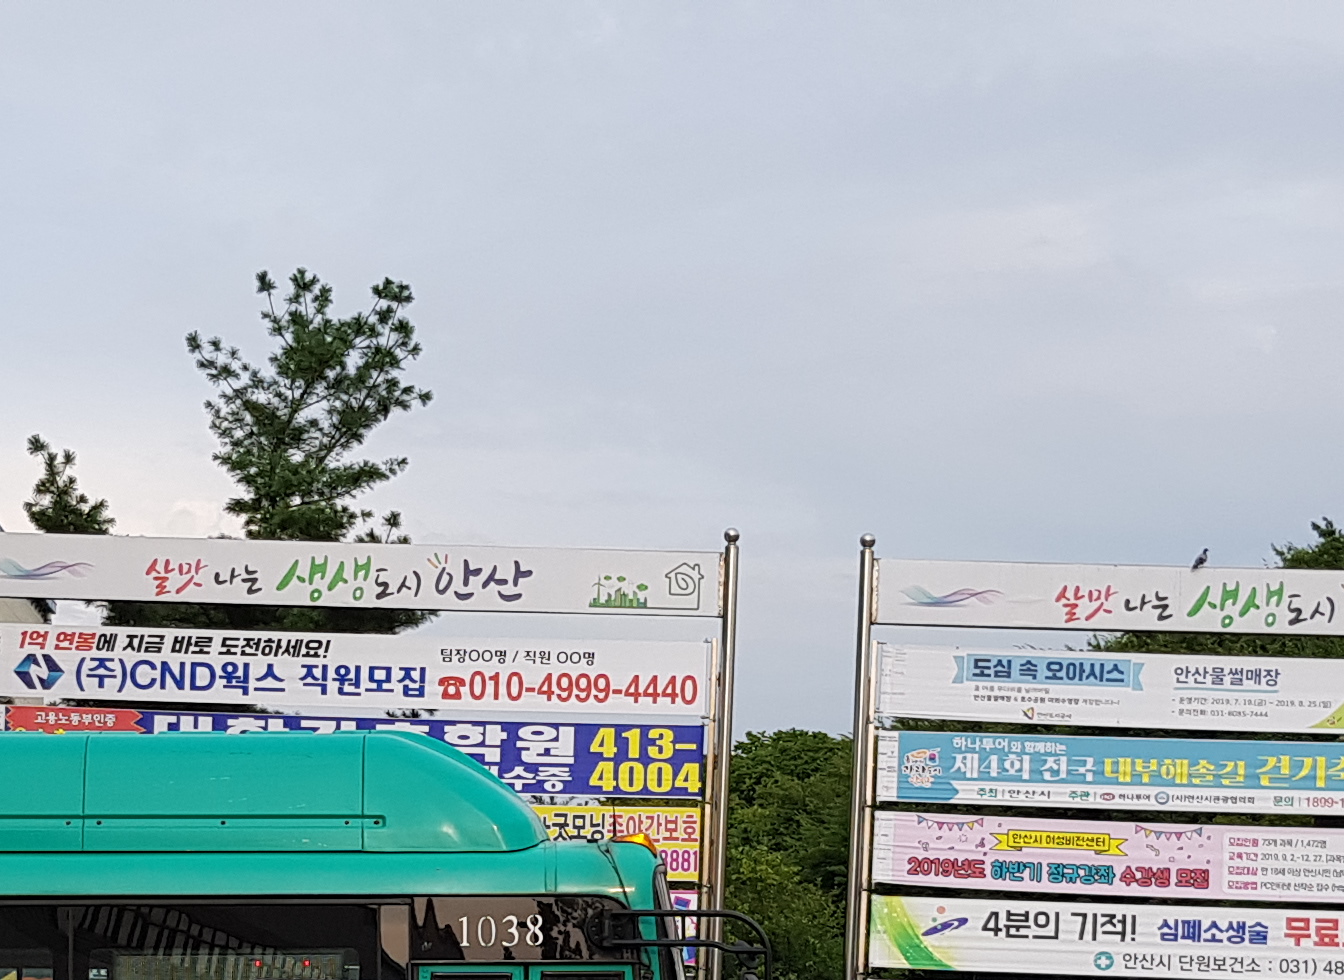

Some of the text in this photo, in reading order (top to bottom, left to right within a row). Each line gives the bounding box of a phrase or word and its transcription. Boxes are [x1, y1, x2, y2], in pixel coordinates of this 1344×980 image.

[434, 556, 533, 602] 안산
[19, 631, 330, 658] 1억 연봉에 지금 바로 도전하세요!
[523, 650, 551, 665] 직원
[76, 659, 426, 699] (주)CND웍스 직원모집
[972, 658, 1124, 683] 도심 속 오아시스
[1174, 666, 1281, 687] 안산물썰매장
[469, 671, 698, 705] 010-4999-4440
[34, 712, 116, 726] 고용노동부인증
[590, 727, 697, 758] 413-
[589, 762, 702, 793] 4004
[951, 752, 1031, 780] 제4회
[1039, 756, 1097, 782] 전국
[1104, 757, 1246, 787] 대부해솔길
[976, 787, 1051, 799] 주최 안산시
[1068, 790, 1090, 801] 주관
[1273, 795, 1294, 807] 문의
[907, 856, 1210, 890] 2019년도 하반기 정규강좌 수강생 모집
[458, 914, 544, 947] 1038
[981, 910, 1059, 941] 4분의
[1070, 911, 1137, 942] 기적!
[1158, 917, 1269, 946] 심폐소생술
[1122, 953, 1172, 971] 안산시
[1179, 954, 1261, 975] 단원보건소
[1278, 957, 1318, 977] 031)
